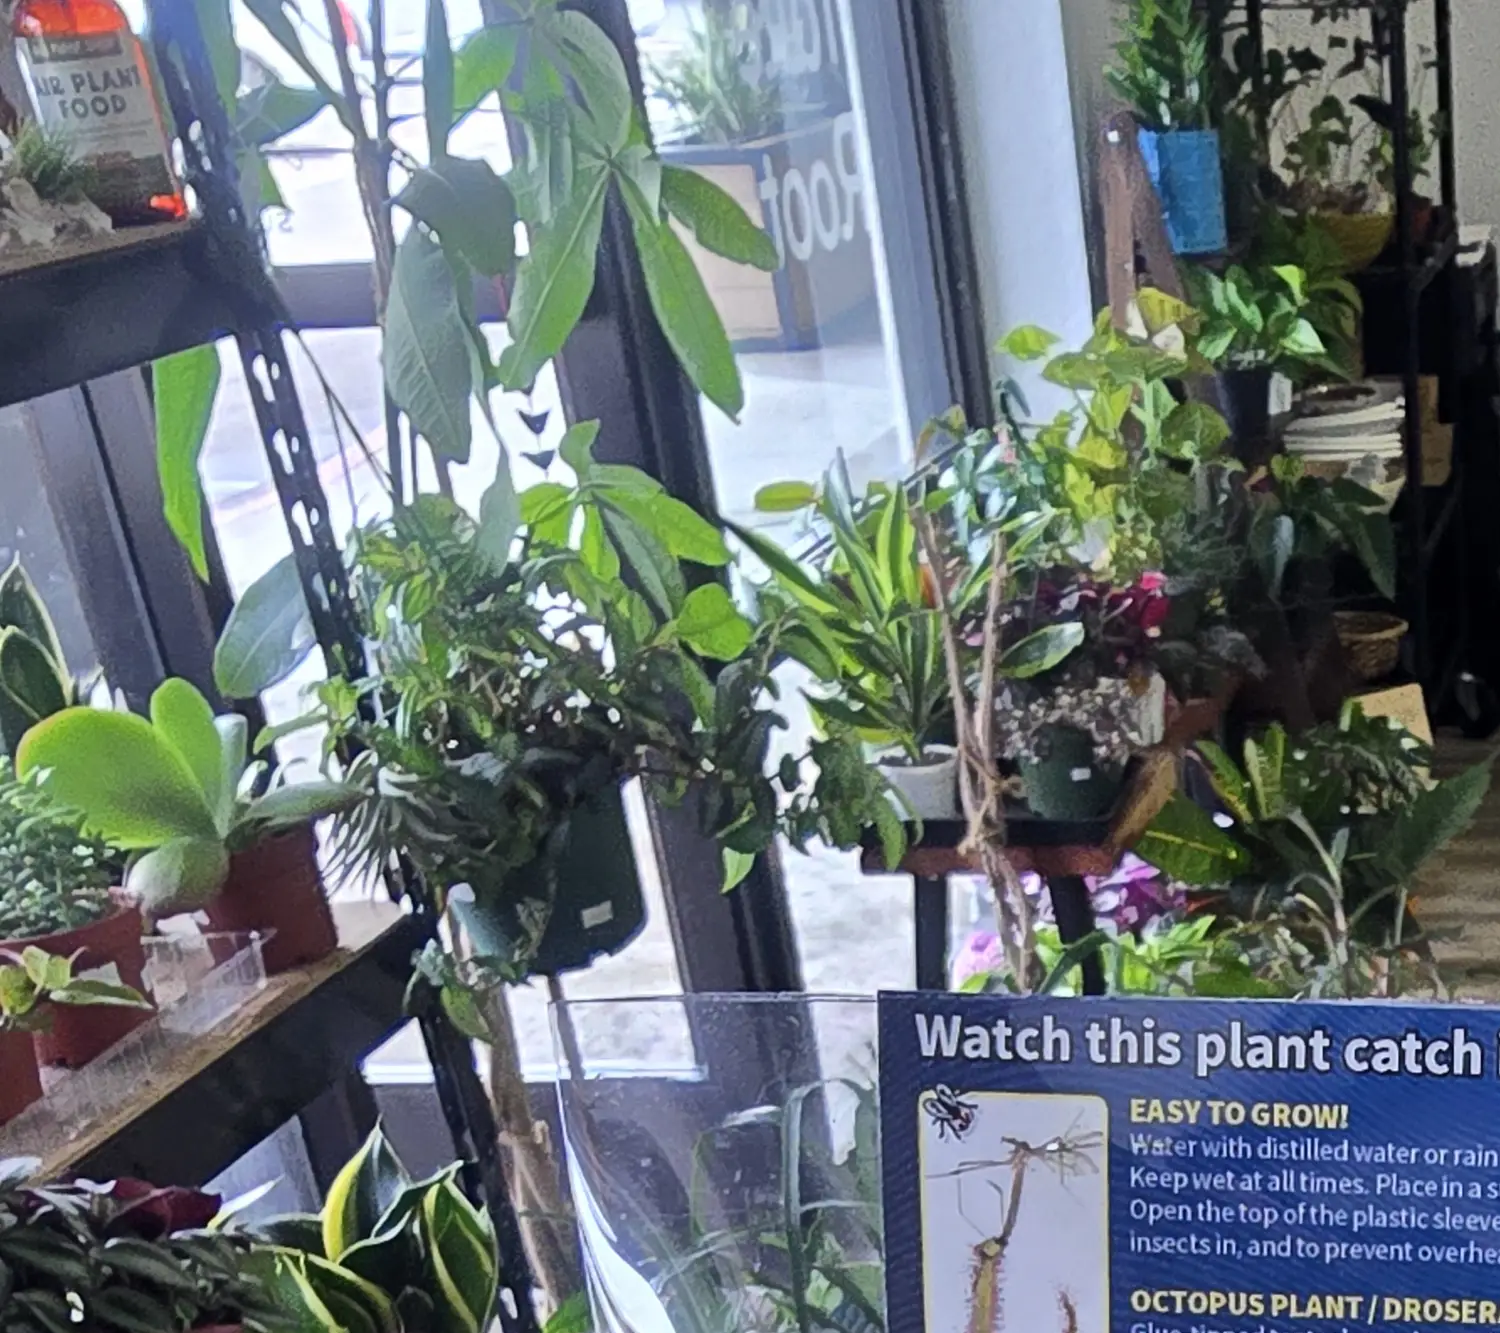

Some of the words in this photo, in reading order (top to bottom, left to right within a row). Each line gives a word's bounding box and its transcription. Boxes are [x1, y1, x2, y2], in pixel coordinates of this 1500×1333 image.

[70, 65, 141, 94] PLANT
[58, 94, 127, 119] FOOD
[915, 1013, 1070, 1061] Watch
[1085, 1017, 1181, 1065] this
[1198, 1021, 1331, 1077] plant
[1344, 1028, 1482, 1075] catch
[1130, 1098, 1200, 1123] EASY
[1206, 1101, 1246, 1125] TO
[1251, 1103, 1349, 1129] GROW!
[1130, 1133, 1197, 1157] Water
[1201, 1136, 1252, 1159] with
[1257, 1136, 1348, 1161] distilled
[1353, 1141, 1417, 1164] water
[1424, 1148, 1448, 1166] or
[1453, 1144, 1498, 1167] rain
[1130, 1167, 1188, 1193] Keep
[1192, 1170, 1235, 1191] wet
[1240, 1171, 1263, 1192] at
[1267, 1169, 1295, 1192] all
[1300, 1171, 1370, 1194] times.
[1376, 1174, 1437, 1197] Place
[1441, 1176, 1463, 1198] in
[1468, 1181, 1482, 1199] a
[1130, 1198, 1192, 1226] Open
[1197, 1200, 1235, 1222] the
[1238, 1203, 1279, 1229] top
[1283, 1202, 1307, 1224] of
[1310, 1204, 1348, 1226] the
[1353, 1204, 1430, 1232] plastic
[1130, 1230, 1211, 1255] insects
[1216, 1232, 1243, 1259] in,
[1247, 1235, 1291, 1257] and
[1296, 1237, 1320, 1259] to
[1325, 1241, 1413, 1264] prevent
[1130, 1289, 1265, 1316] OCTOPUS
[1271, 1294, 1364, 1319] PLANT
[1367, 1294, 1379, 1325] /
